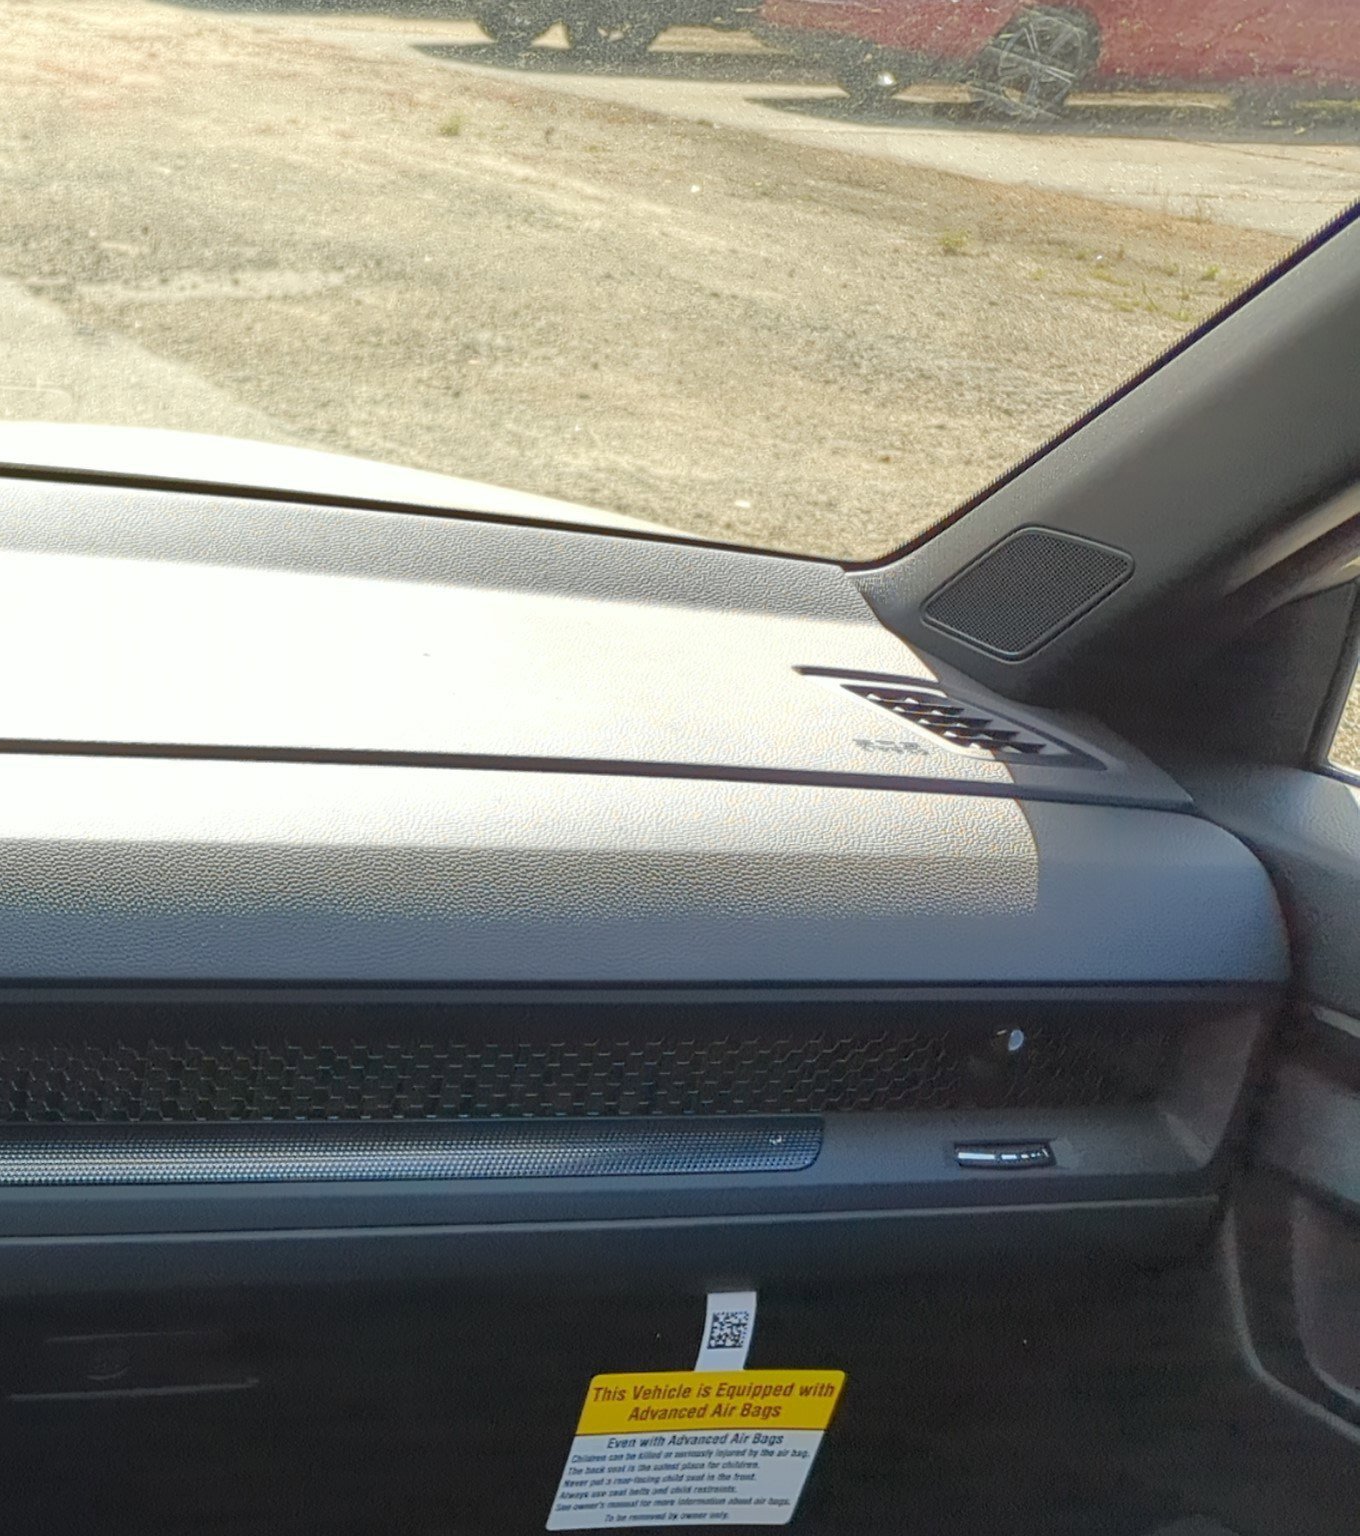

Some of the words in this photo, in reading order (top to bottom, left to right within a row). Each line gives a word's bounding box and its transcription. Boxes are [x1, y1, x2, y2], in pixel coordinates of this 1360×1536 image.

[592, 1387, 626, 1402] This
[632, 1384, 691, 1401] Vehicle
[697, 1384, 710, 1399] is
[716, 1382, 795, 1402] Equipped
[799, 1382, 835, 1398] with
[627, 1405, 706, 1422] Advanced
[710, 1403, 736, 1418] Air
[740, 1402, 782, 1420] Bags
[607, 1437, 637, 1449] Even
[639, 1436, 666, 1448] with
[667, 1434, 729, 1446] Advanced
[730, 1433, 751, 1445] Air
[752, 1433, 784, 1447] Bags
